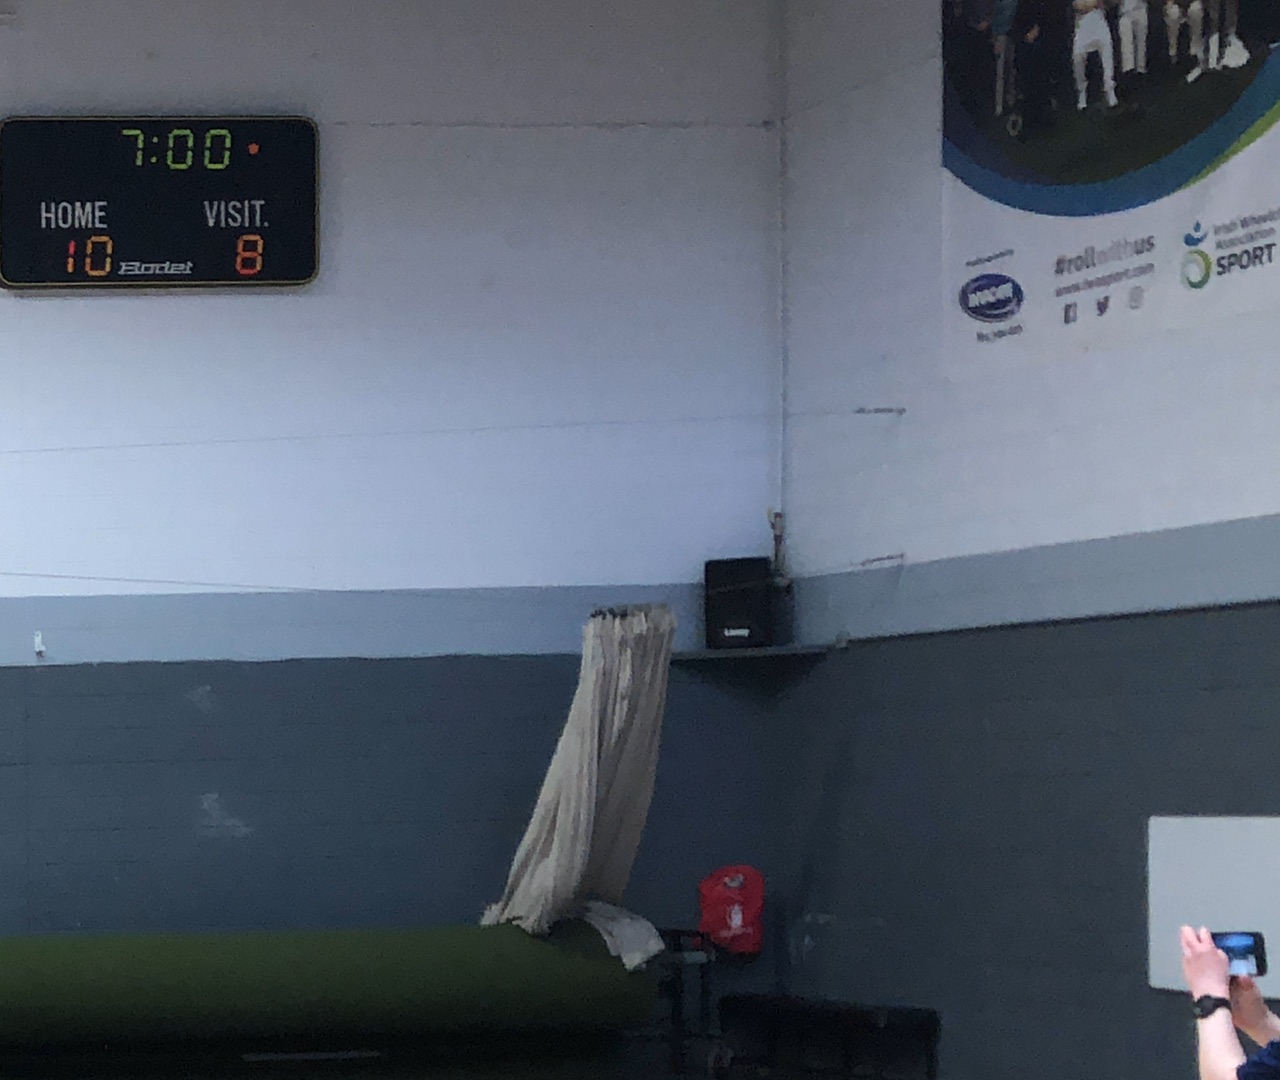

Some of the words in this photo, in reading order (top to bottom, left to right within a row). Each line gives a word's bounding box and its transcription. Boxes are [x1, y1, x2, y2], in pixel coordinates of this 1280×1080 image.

[121, 128, 231, 170] 7:00
[40, 201, 108, 229] HOME
[203, 200, 270, 228] VISIT.
[66, 235, 114, 277] 10
[118, 261, 194, 275] Bodet
[235, 234, 264, 275] 8
[1216, 243, 1277, 275] SPORT
